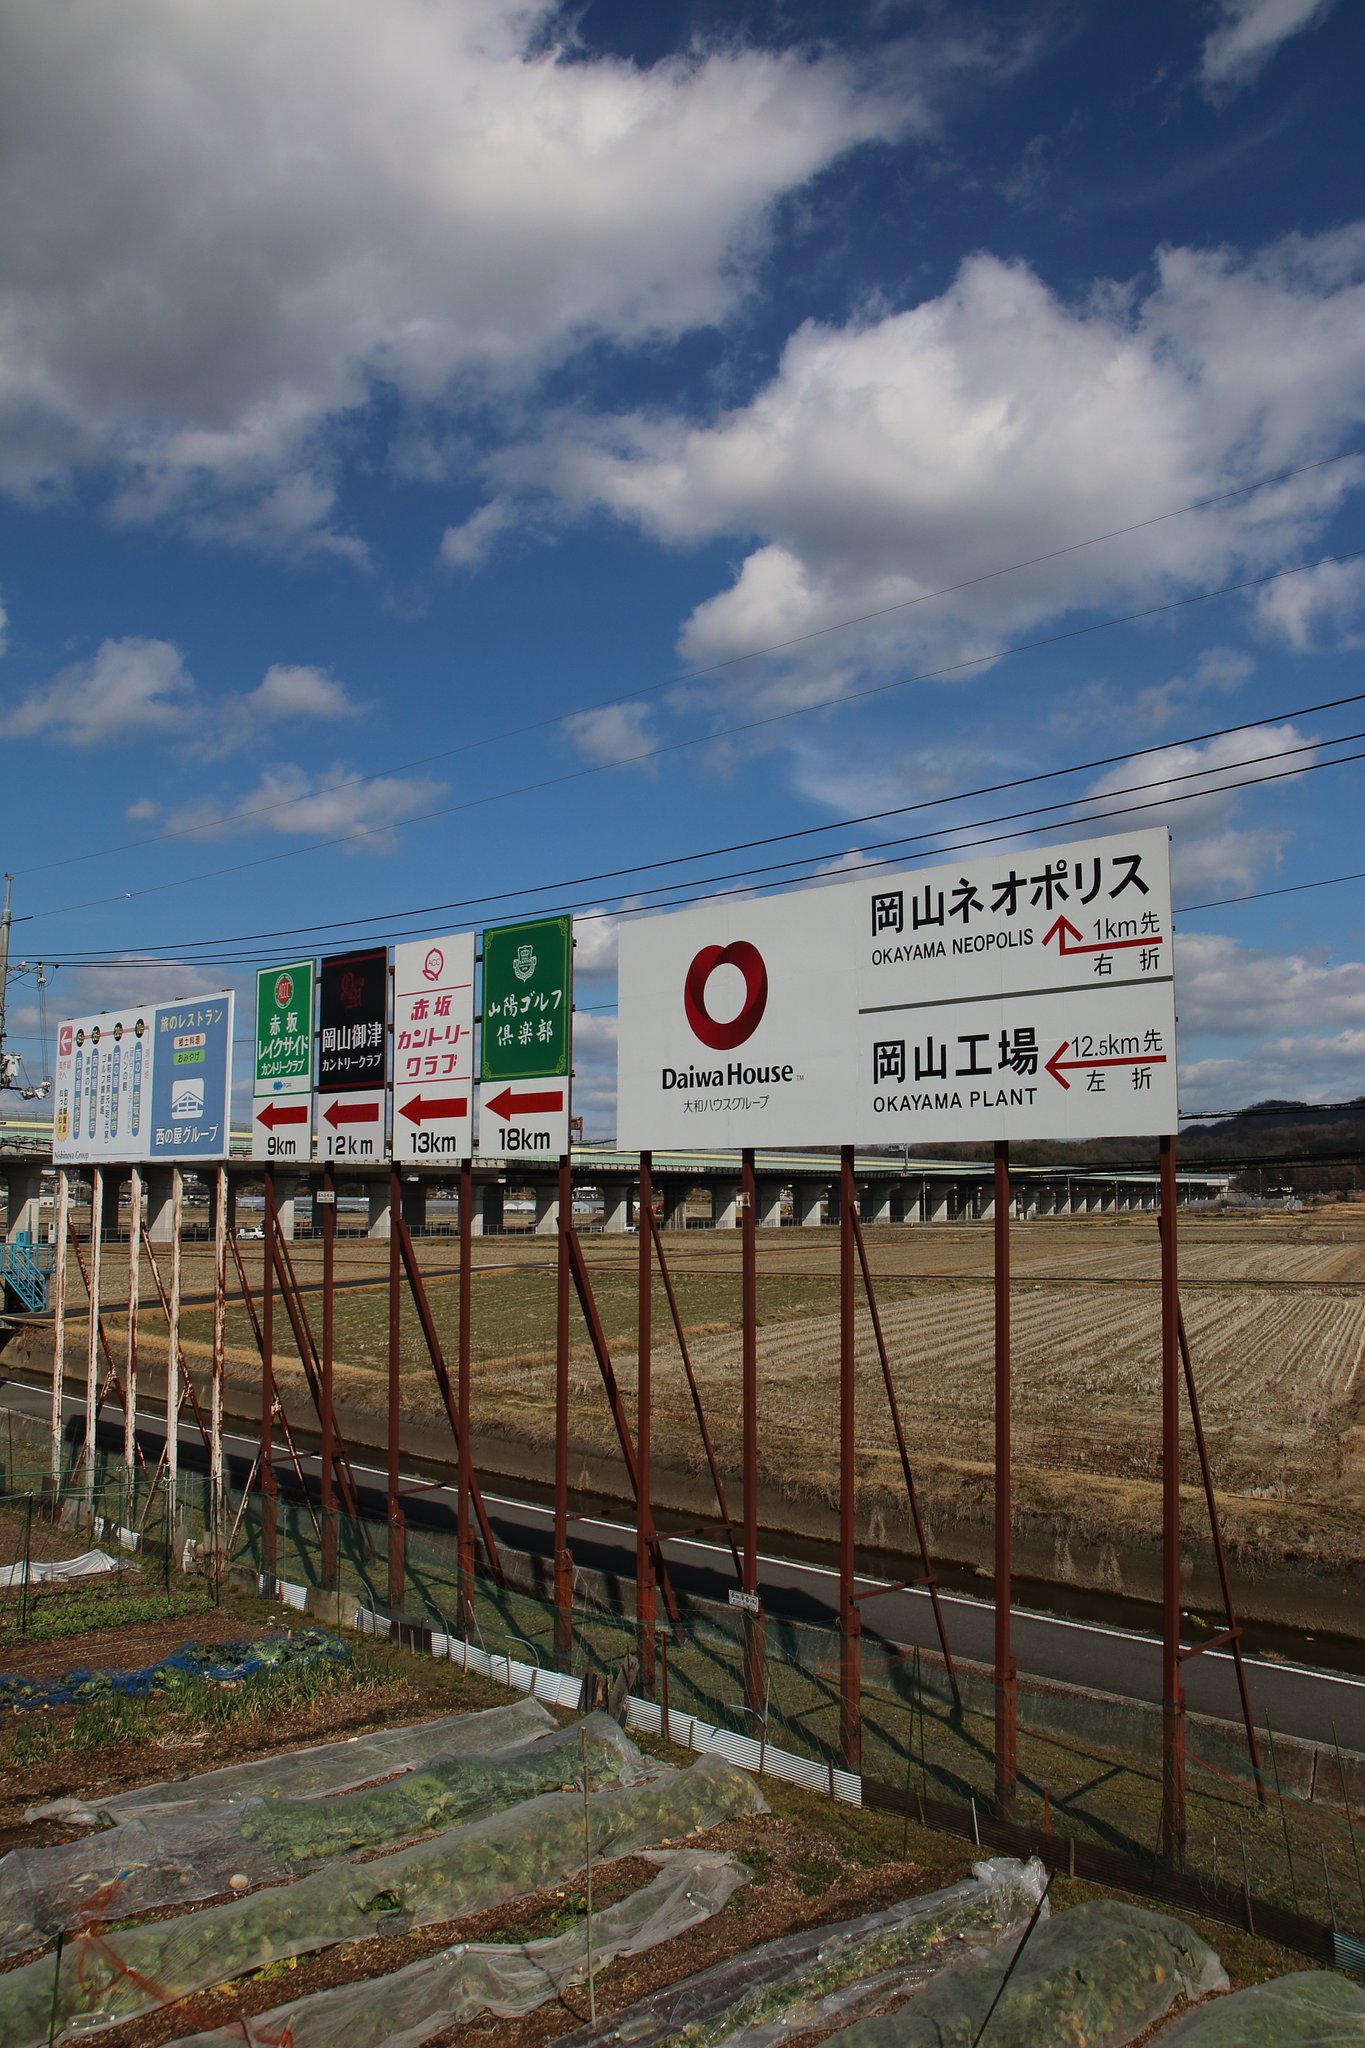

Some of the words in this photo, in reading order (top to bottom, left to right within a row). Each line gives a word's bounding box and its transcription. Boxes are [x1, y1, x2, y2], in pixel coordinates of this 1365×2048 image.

[872, 854, 1149, 936] 岡山ネオポリス
[1093, 911, 1160, 941] 1km先
[872, 940, 946, 965] OKAYAMA
[952, 928, 1033, 955] NEOPOLIS
[428, 958, 440, 967] ACC
[410, 995, 452, 1021] 赤坂
[488, 989, 562, 1018] 山陽ゴルフ
[160, 1009, 223, 1033] 旅のレストラン
[269, 1011, 298, 1037] 赤坂
[496, 1018, 553, 1046] 倶楽部
[258, 1035, 309, 1060] レイクサイド
[322, 1021, 382, 1053] 岡山御津
[397, 1024, 470, 1050] カントリー
[1071, 1028, 1163, 1058] 12.5km先
[177, 1051, 201, 1063] おみやげ
[261, 1058, 305, 1076] カントリークラブ
[321, 1053, 382, 1072] カントリークラブ
[406, 1053, 457, 1077] クラブ
[873, 1027, 1039, 1084] 岡山工場
[684, 1095, 770, 1113] 大和ハウスグループ
[873, 1092, 962, 1112] OKAYAMA
[970, 1088, 1038, 1107] PLANT
[156, 1123, 219, 1146] 西の屋グループ
[267, 1136, 296, 1156] 9km
[327, 1135, 373, 1155] 12km
[410, 1132, 456, 1154] 13km
[499, 1128, 550, 1150] 18km
[75, 1150, 89, 1161] Group
